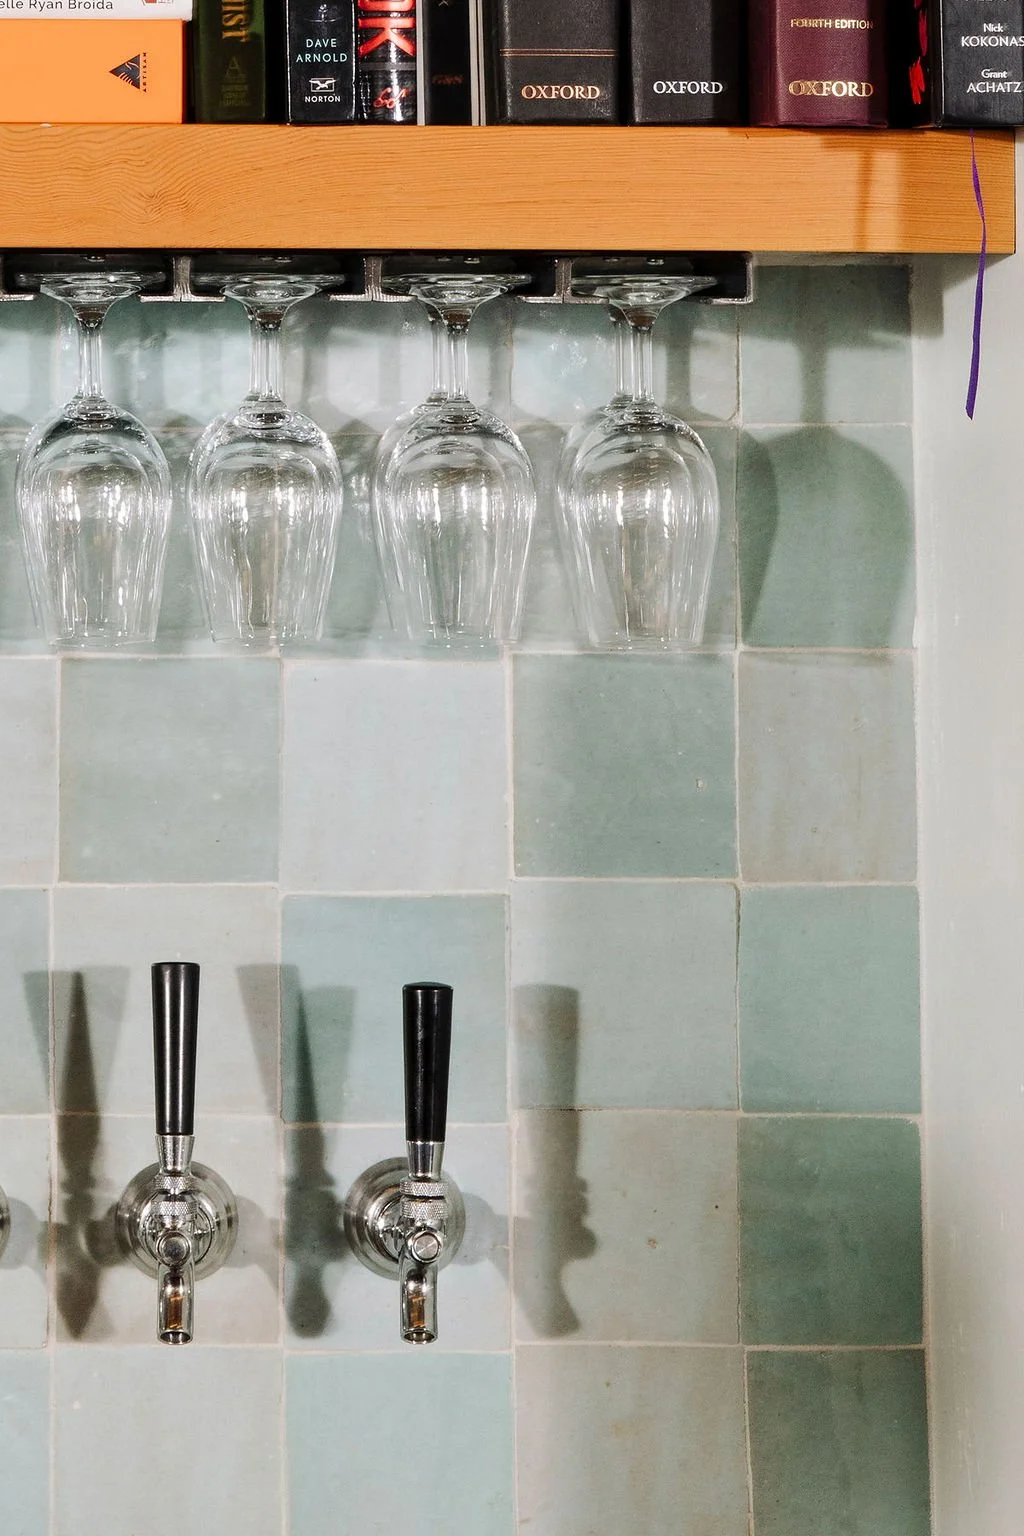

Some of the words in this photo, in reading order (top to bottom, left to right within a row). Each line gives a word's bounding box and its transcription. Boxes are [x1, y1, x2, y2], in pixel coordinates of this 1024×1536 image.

[790, 18, 832, 28] FOURTH
[834, 19, 874, 29] EDITION
[983, 23, 1004, 32] Nick
[306, 39, 337, 48] DAVE
[961, 36, 1024, 47] KOKONAS
[296, 53, 348, 63] ARNOLD
[981, 69, 1008, 78] Grant
[521, 84, 601, 99] OXFORD
[653, 80, 723, 95] OXFORD
[788, 79, 874, 97] OXFORD
[967, 82, 1022, 93] ACHATZ
[304, 95, 341, 103] NORTON
